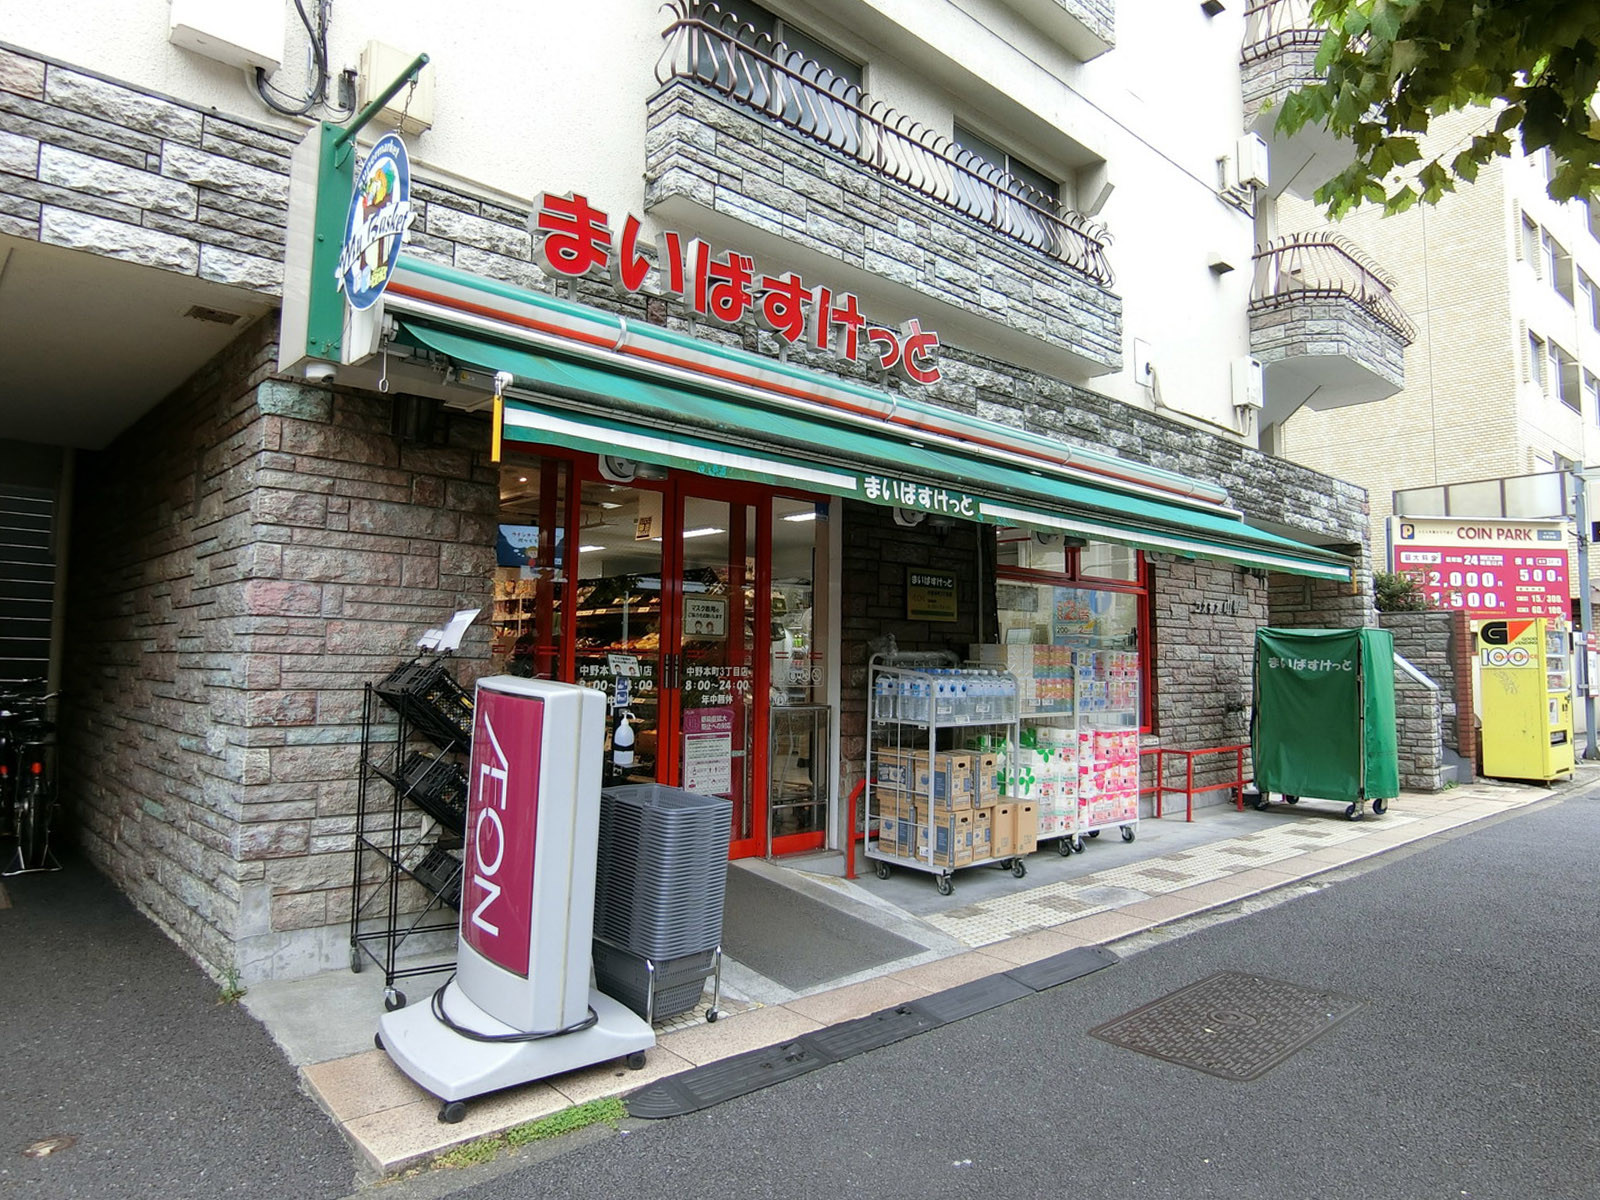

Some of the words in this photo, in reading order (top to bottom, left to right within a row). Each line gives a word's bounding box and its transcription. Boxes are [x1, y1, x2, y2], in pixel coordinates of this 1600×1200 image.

[532, 191, 941, 386] まいばすけっと
[864, 476, 974, 516] まいばすけっと
[1457, 527, 1492, 540] COIN
[1497, 528, 1532, 540] PARK
[1463, 555, 1479, 566] 24
[911, 575, 953, 588] まいばすけっと
[1481, 647, 1529, 666] 100
[1267, 656, 1352, 672] まいばすけっと
[686, 666, 749, 677] 中野本町3丁目店
[701, 694, 733, 705] 年中無休
